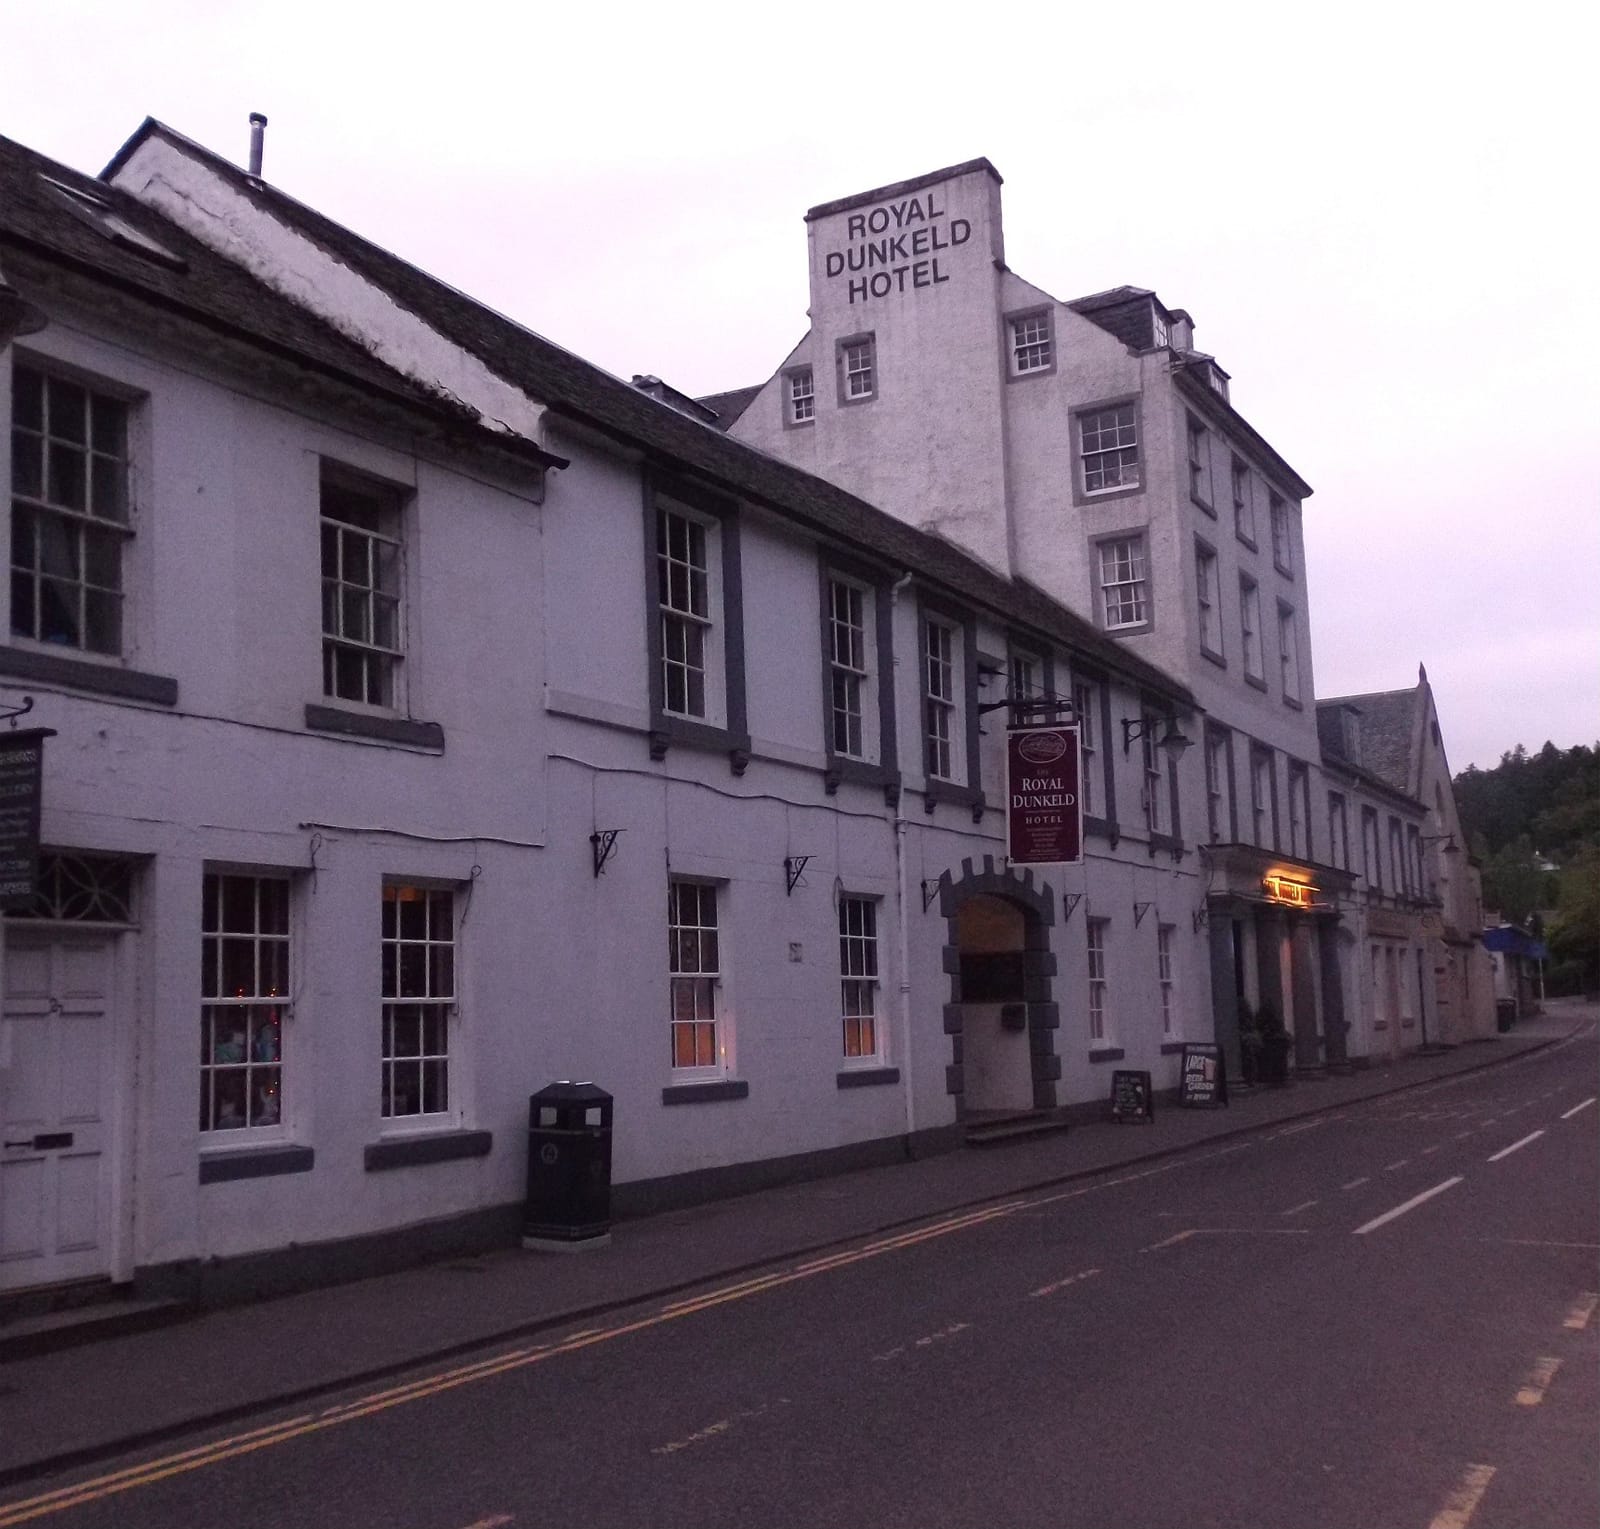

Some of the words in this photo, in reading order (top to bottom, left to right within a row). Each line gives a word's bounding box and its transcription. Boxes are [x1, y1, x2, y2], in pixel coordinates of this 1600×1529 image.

[848, 193, 944, 241] ROYAL
[826, 218, 971, 278] DUNKELD
[849, 258, 949, 304] HOTEL
[1022, 777, 1064, 792] ROYAL
[1013, 793, 1075, 809] DUNKELD
[1025, 815, 1063, 825] HOTEL
